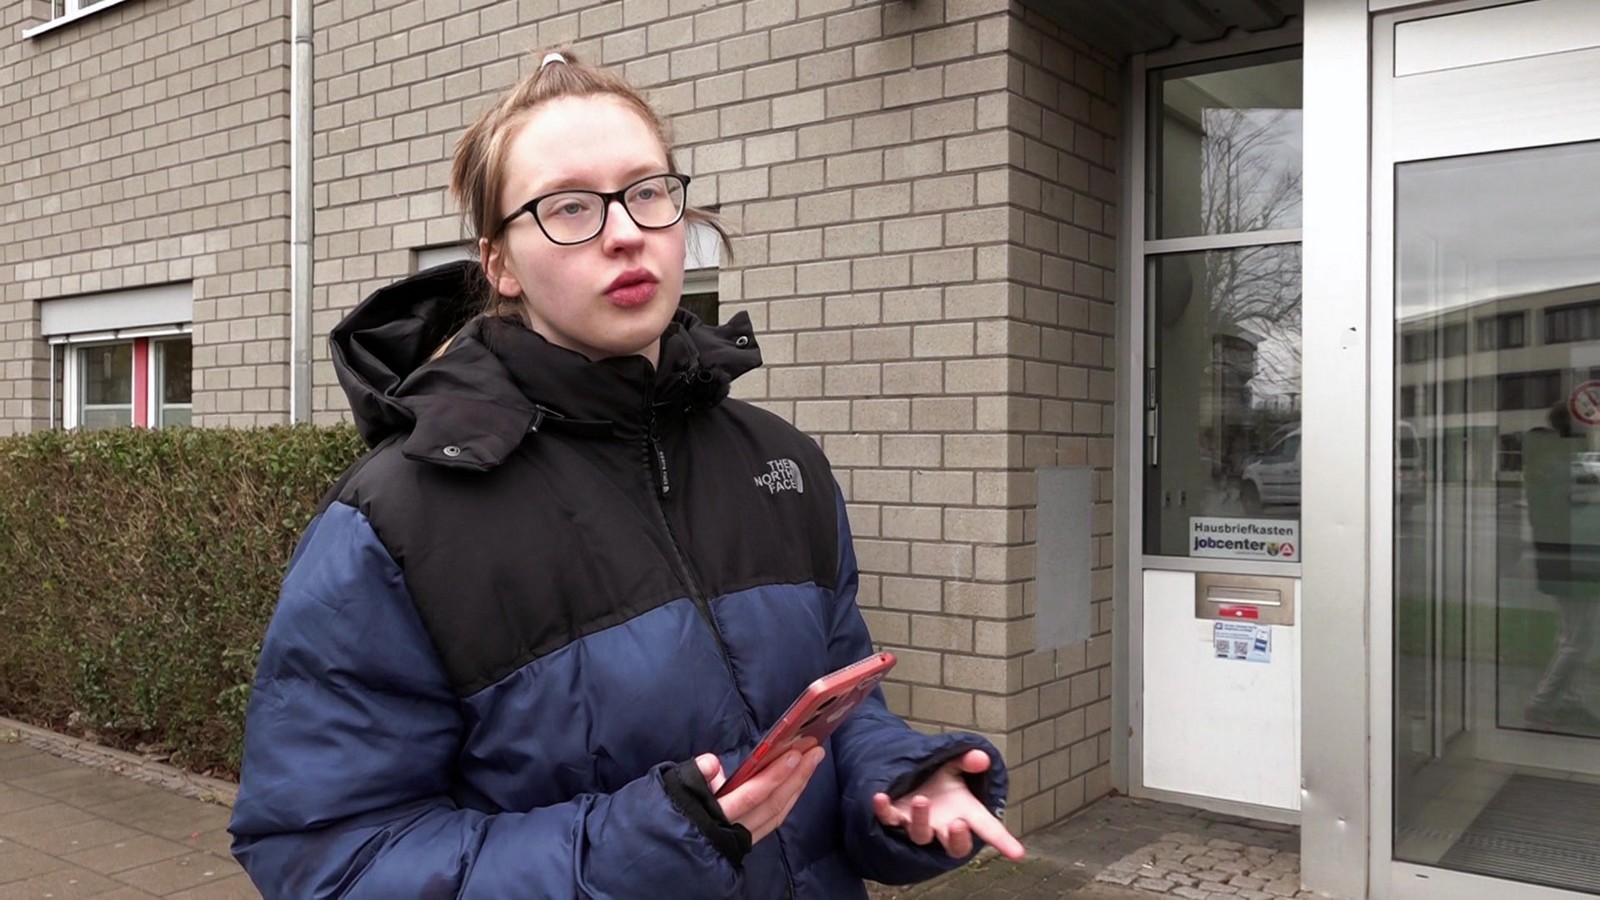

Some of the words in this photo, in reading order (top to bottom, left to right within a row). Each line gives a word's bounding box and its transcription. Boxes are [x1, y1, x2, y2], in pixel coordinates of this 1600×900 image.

[766, 459, 790, 471] THE
[753, 468, 792, 487] NORTH
[768, 479, 797, 494] FACE
[1194, 522, 1293, 536] Hausbriefkasten
[1194, 537, 1266, 551] jobcenter
